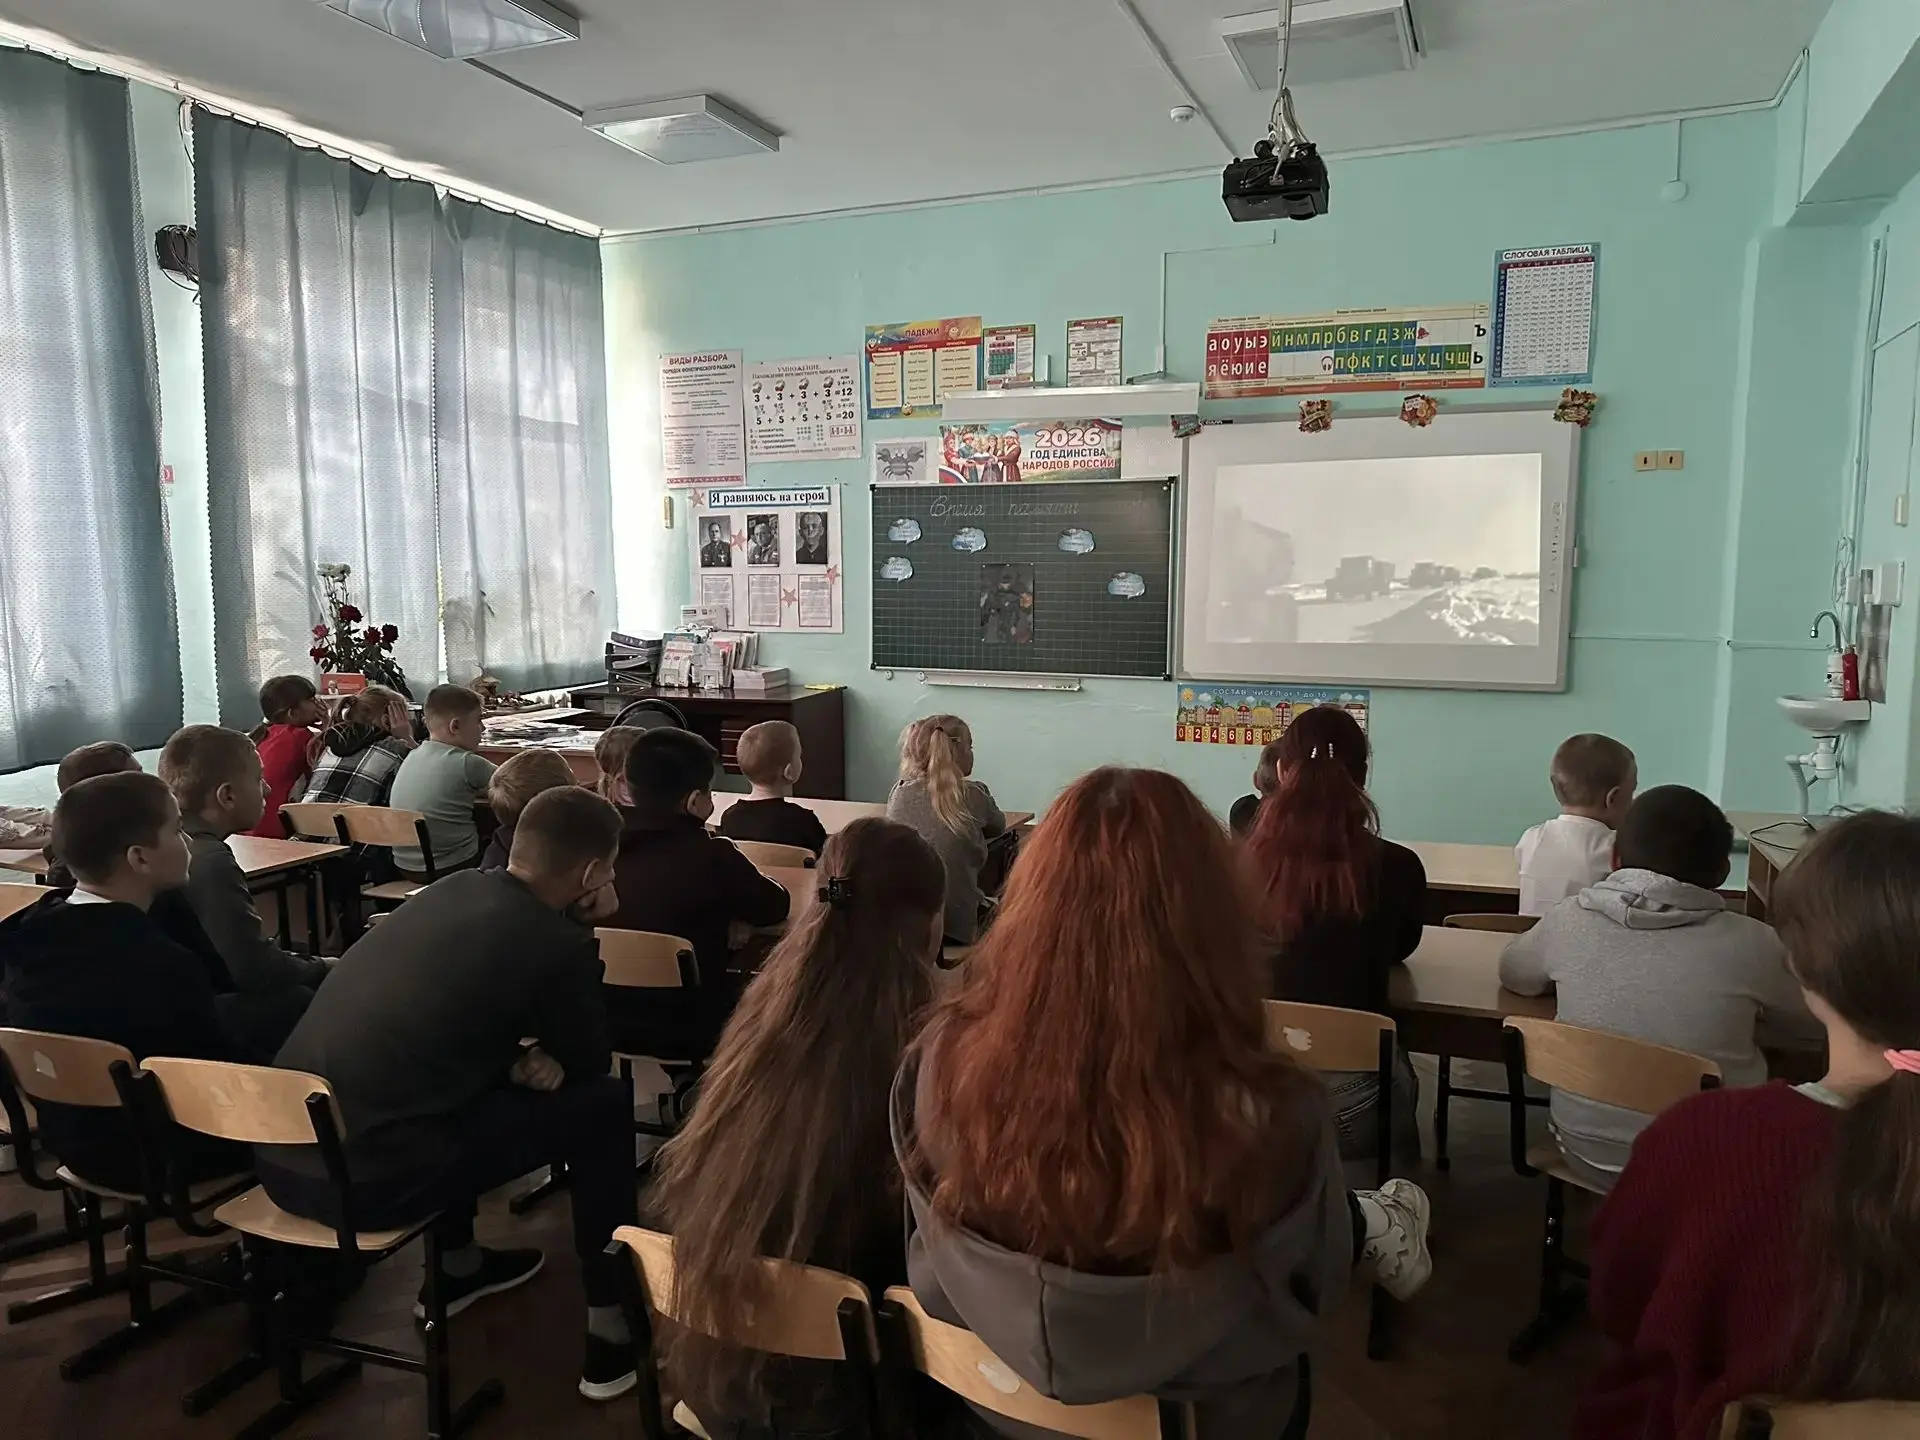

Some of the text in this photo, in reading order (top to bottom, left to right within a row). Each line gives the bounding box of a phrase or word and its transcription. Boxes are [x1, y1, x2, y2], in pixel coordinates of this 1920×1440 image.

[1504, 246, 1590, 260] СЛОГОВАЯ ТАБЛИЦА
[906, 328, 940, 337] ПАДЕЖИ
[670, 354, 728, 365] ВИДЫ РАЗБОРА
[1035, 428, 1101, 448] 2026
[1030, 448, 1106, 459] ГОД ЕДИНСТВА
[1022, 459, 1114, 470] НАРОДОВ РОССИИ
[712, 493, 720, 503] Я
[724, 492, 775, 505] равняюсь
[794, 492, 824, 503] героя
[1179, 728, 1184, 738] 0
[1195, 729, 1200, 738] 2
[1203, 729, 1208, 739] 3
[1212, 730, 1217, 739] 4
[1221, 730, 1226, 739] 5
[1229, 730, 1235, 740] 6
[1238, 730, 1243, 740] 7
[1246, 730, 1252, 741] 8
[1255, 731, 1260, 741] 9
[1263, 732, 1270, 742] 10
